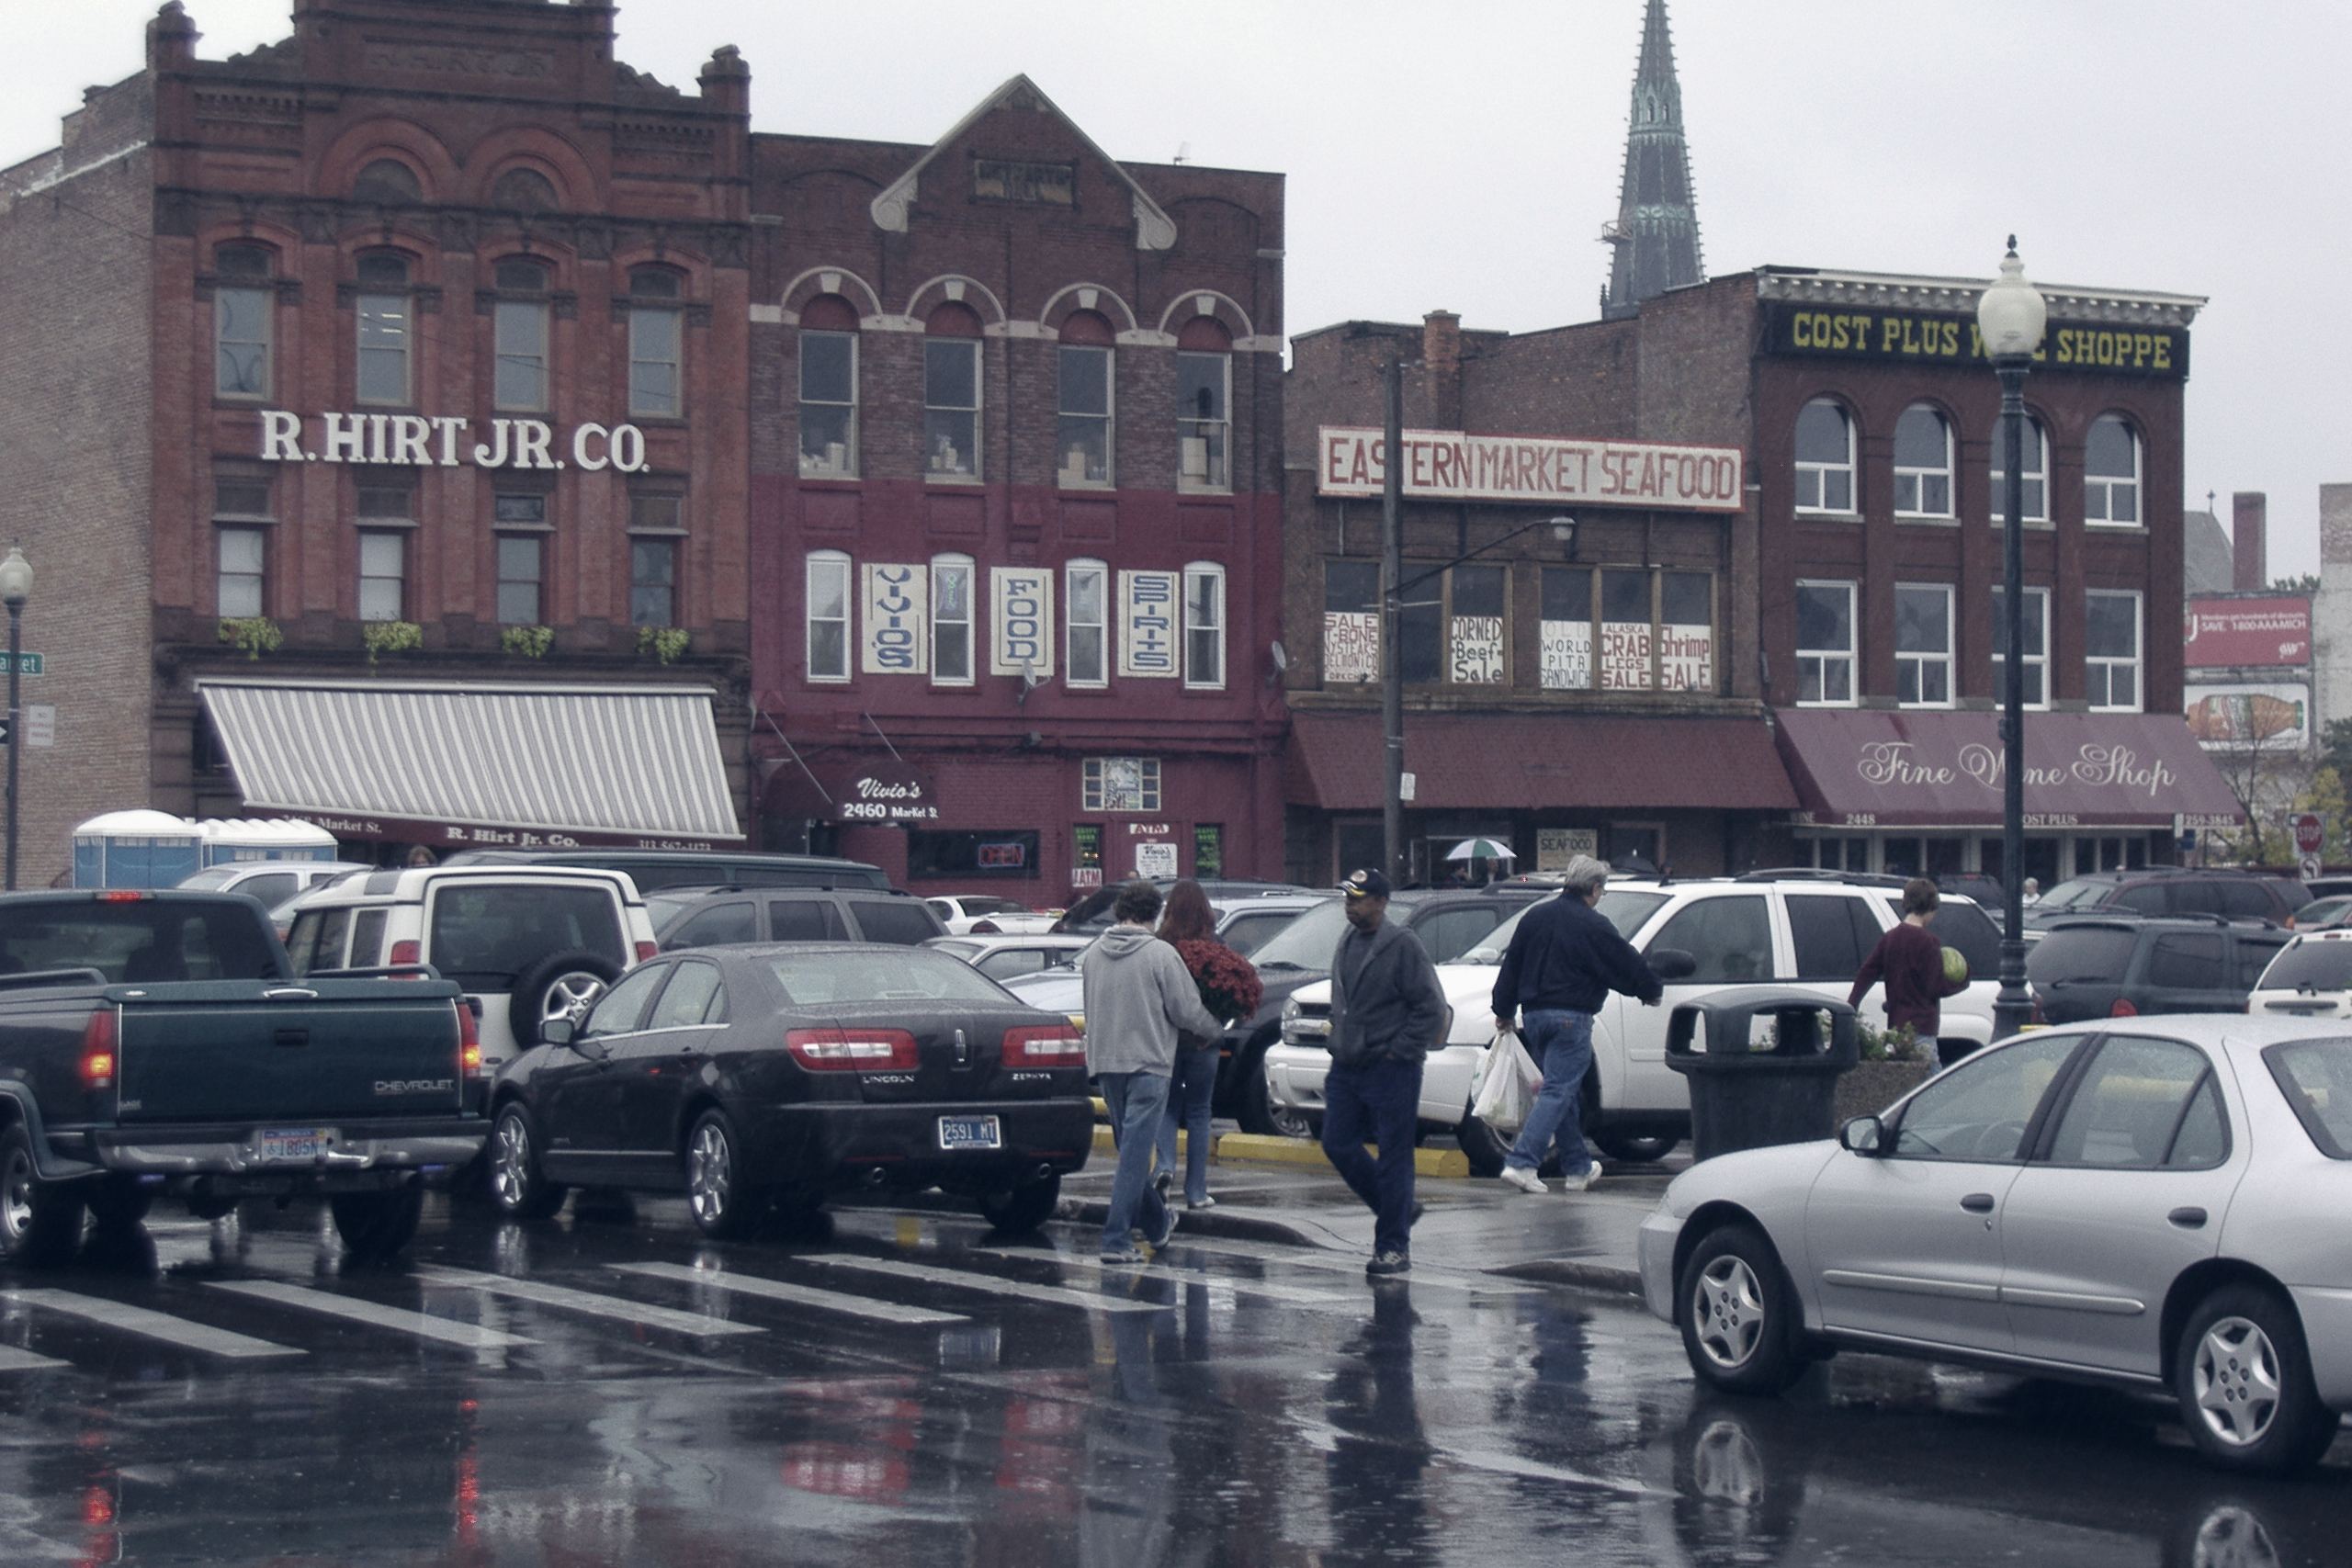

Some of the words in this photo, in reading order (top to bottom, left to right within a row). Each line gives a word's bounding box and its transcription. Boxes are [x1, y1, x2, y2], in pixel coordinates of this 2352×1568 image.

[1792, 312, 1871, 350] COST
[1882, 319, 1959, 355] PLUS
[2058, 330, 2171, 368] SHOPPE
[261, 410, 317, 461] R.
[323, 412, 467, 467] HIRT
[474, 419, 565, 469] JR.
[573, 422, 650, 473] CO.
[1477, 443, 1594, 493] MARKET
[1600, 449, 1735, 501] SEAFOOD
[1007, 578, 1038, 660] FOOD
[1134, 574, 1170, 668] SPIRITS
[1325, 614, 1377, 629] SALE
[1324, 628, 1377, 643] T-BONE
[1452, 618, 1502, 641] CORNED
[1545, 622, 1587, 637] OLD
[1606, 625, 1645, 634] ALASKA
[1542, 639, 1591, 653] WORLD
[1602, 633, 1651, 657] CRAB
[1660, 626, 1710, 662] Shrimp
[1548, 654, 1586, 668] PITA
[1606, 658, 1645, 670] LEGS
[1455, 660, 1503, 682] Sale
[1541, 668, 1591, 687] SANDWICH
[1601, 671, 1652, 688] SALE
[1660, 663, 1711, 690] SALE
[1857, 741, 1956, 784] Fine
[1959, 742, 2067, 793] Wne
[2072, 742, 2177, 796] Shop
[856, 777, 922, 798] Vivio's
[843, 803, 887, 818] 2460
[318, 817, 362, 833] Market
[1846, 814, 1876, 825] 2448
[2023, 814, 2045, 826] OST
[2048, 814, 2078, 826] PLUS
[447, 827, 469, 840] R.
[474, 829, 515, 844] Hirt
[521, 832, 543, 847] Jr.
[548, 834, 581, 848] Co.
[1541, 837, 1593, 851] SEAFOOD
[374, 1078, 455, 1092] CHEVROLET
[862, 1075, 916, 1084] LINCOLN
